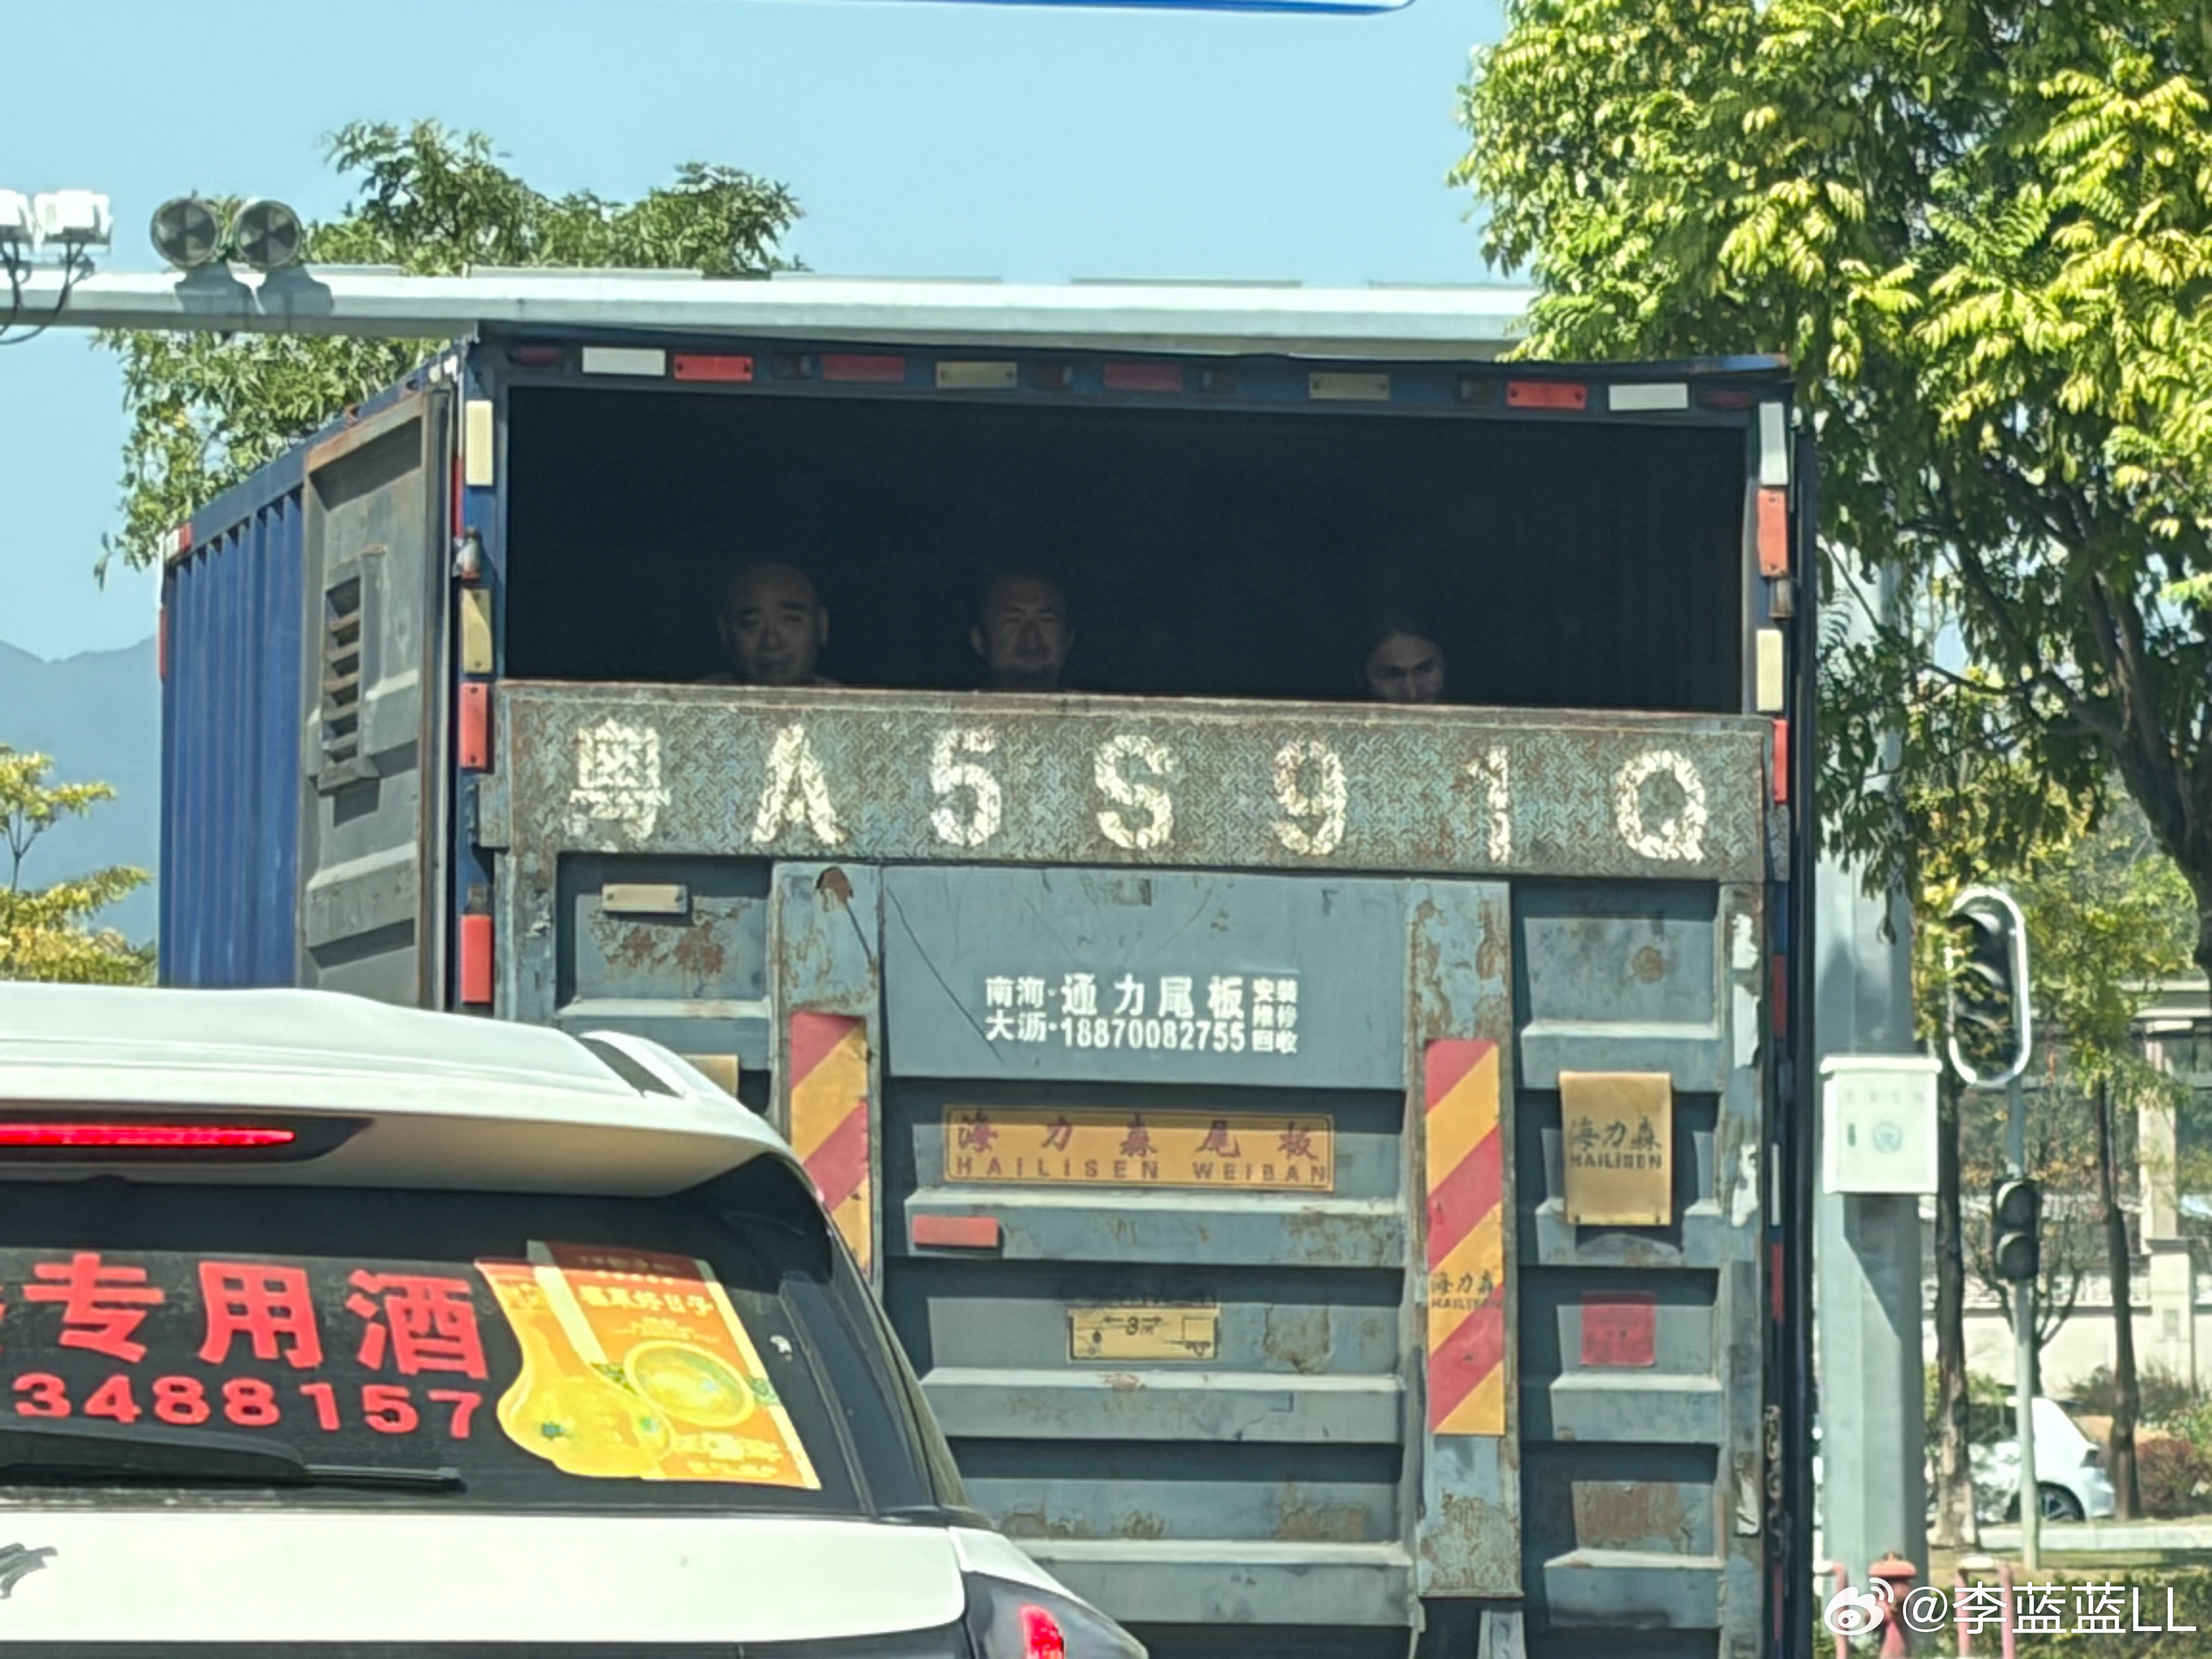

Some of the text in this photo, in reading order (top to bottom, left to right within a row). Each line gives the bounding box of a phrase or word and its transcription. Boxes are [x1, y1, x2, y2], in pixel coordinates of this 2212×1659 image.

[1571, 1115, 1663, 1152] 海力森
[956, 1156, 1329, 1182] HAILISEN WEIBAN
[1570, 1153, 1663, 1169] HAILISEN
[0, 1252, 489, 1379] 专用酒
[13, 1372, 483, 1439] 3488157
